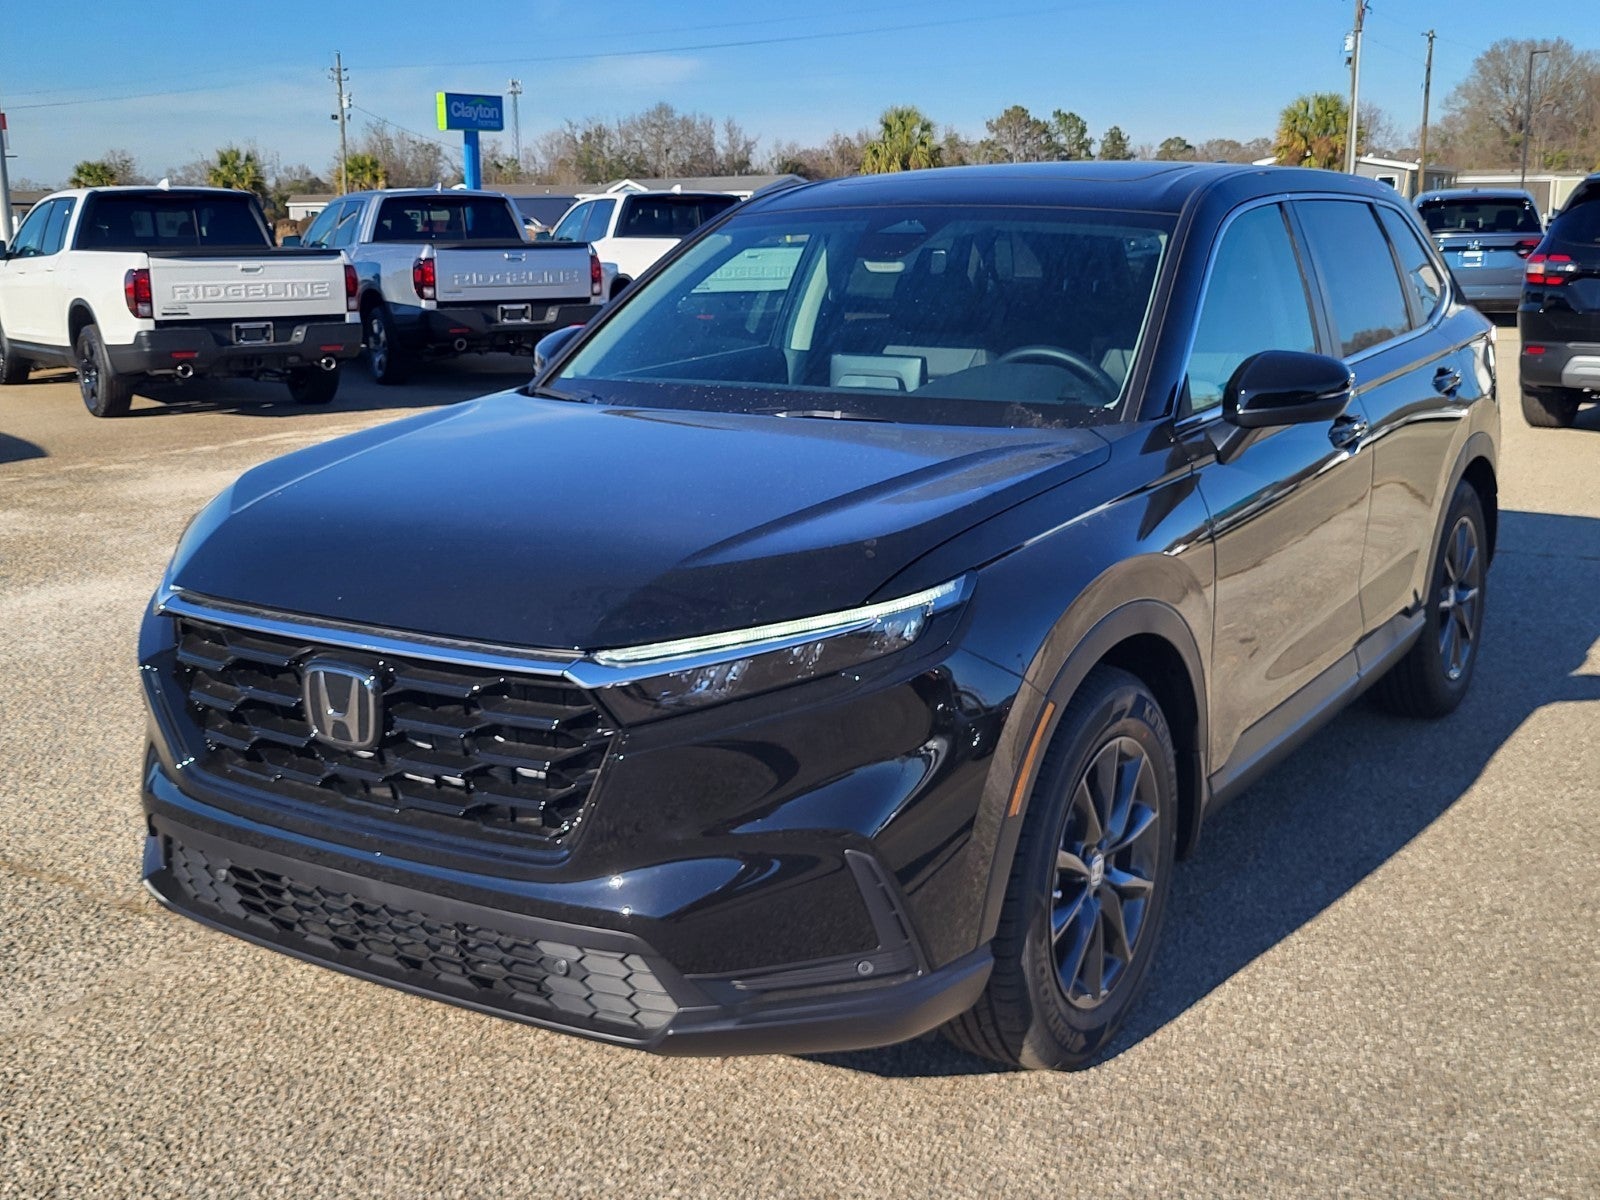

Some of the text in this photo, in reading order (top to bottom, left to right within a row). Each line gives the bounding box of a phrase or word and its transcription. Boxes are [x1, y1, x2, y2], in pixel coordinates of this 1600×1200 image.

[450, 101, 499, 121] Clayton
[453, 270, 579, 285] RIDGELINE
[172, 282, 330, 301] RIDGELINE
